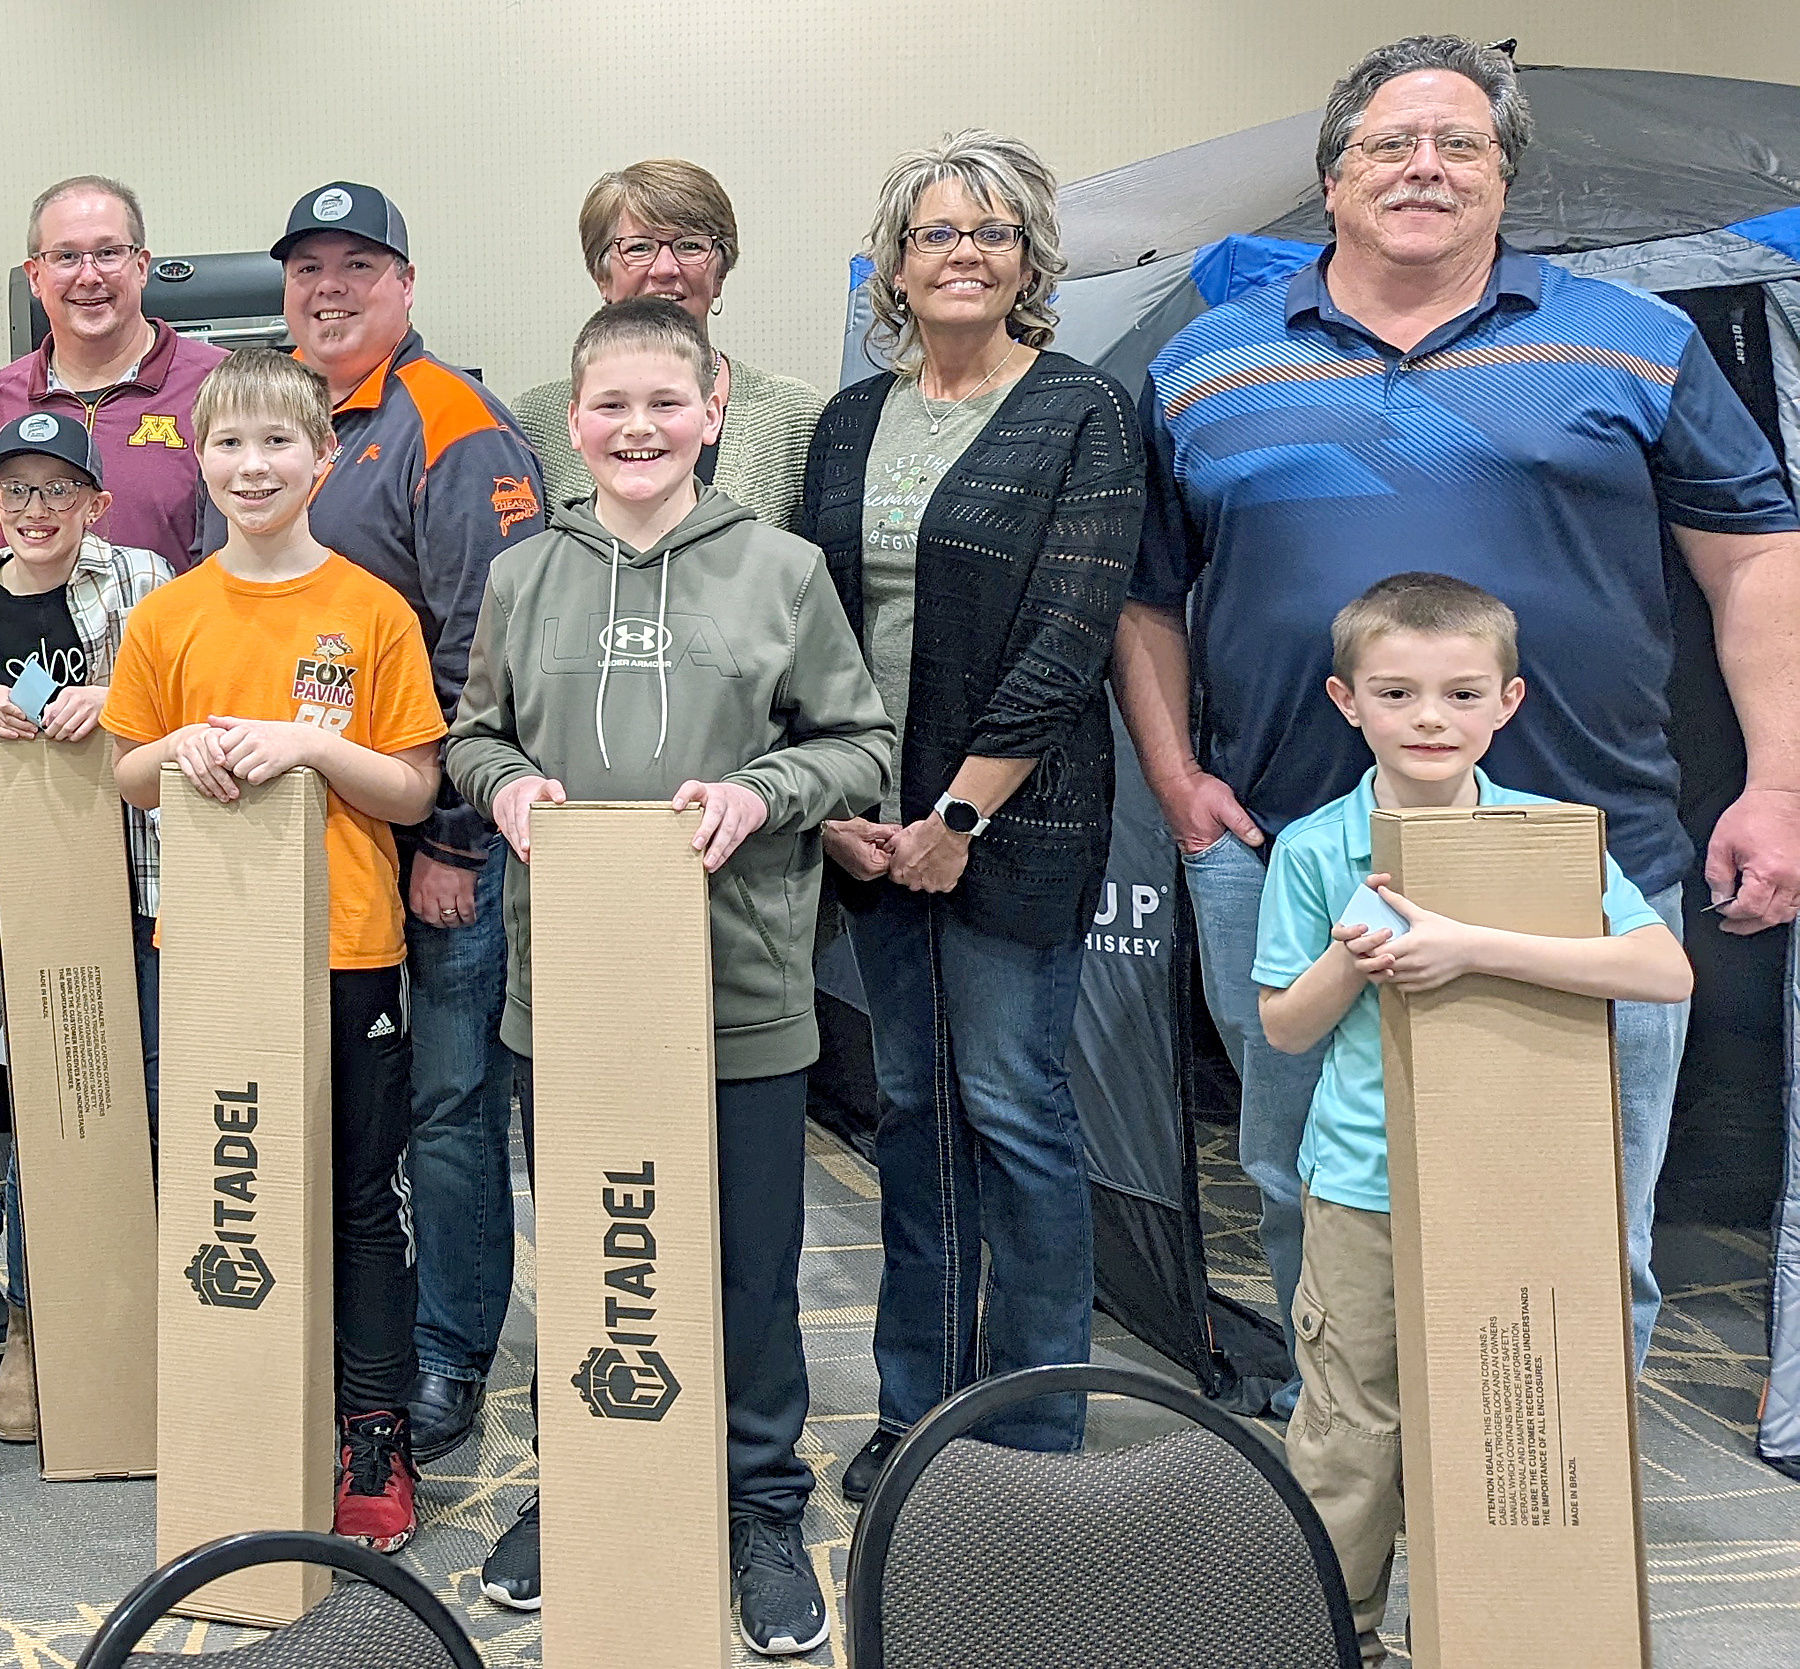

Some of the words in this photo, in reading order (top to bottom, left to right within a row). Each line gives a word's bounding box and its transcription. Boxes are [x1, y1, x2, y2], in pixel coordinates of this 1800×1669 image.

[1732, 325, 1745, 364] Otter
[128, 414, 184, 448] M
[884, 454, 919, 473] LET
[296, 658, 357, 689] FOX
[598, 659, 629, 667] UDER
[631, 659, 672, 667] ARMOR
[293, 681, 354, 706] PAVING
[1084, 932, 1160, 957] HISKEY
[367, 1026, 395, 1038] adidas
[1490, 1316, 1499, 1354] OWNERS
[1522, 1287, 1531, 1351] UNDERSTANDS
[1481, 1334, 1489, 1377] CONTAINS
[1512, 1323, 1522, 1381] INFORMATION
[1483, 1380, 1491, 1415] CARTON
[1504, 1363, 1512, 1412] IMPORTANT
[1526, 1374, 1534, 1416] RECEIVES
[1494, 1388, 1503, 1450] TRIGGERLOCK
[1515, 1384, 1525, 1445] MAINTENANCE
[1506, 1415, 1515, 1457] CONTAINS
[1528, 1418, 1536, 1466] CUSTOMER
[1508, 1460, 1516, 1489] WHICH
[1518, 1448, 1526, 1465] AND
[1569, 1457, 1577, 1488] BRAZIL
[1519, 1466, 1529, 1525] OPERATIONAL
[1540, 1451, 1549, 1506] IMPORTANCE
[1488, 1478, 1496, 1525] ATTENTION
[1498, 1475, 1507, 1525] CABLELOCK
[1510, 1490, 1518, 1525] MANUAL
[1531, 1489, 1539, 1511] SURE
